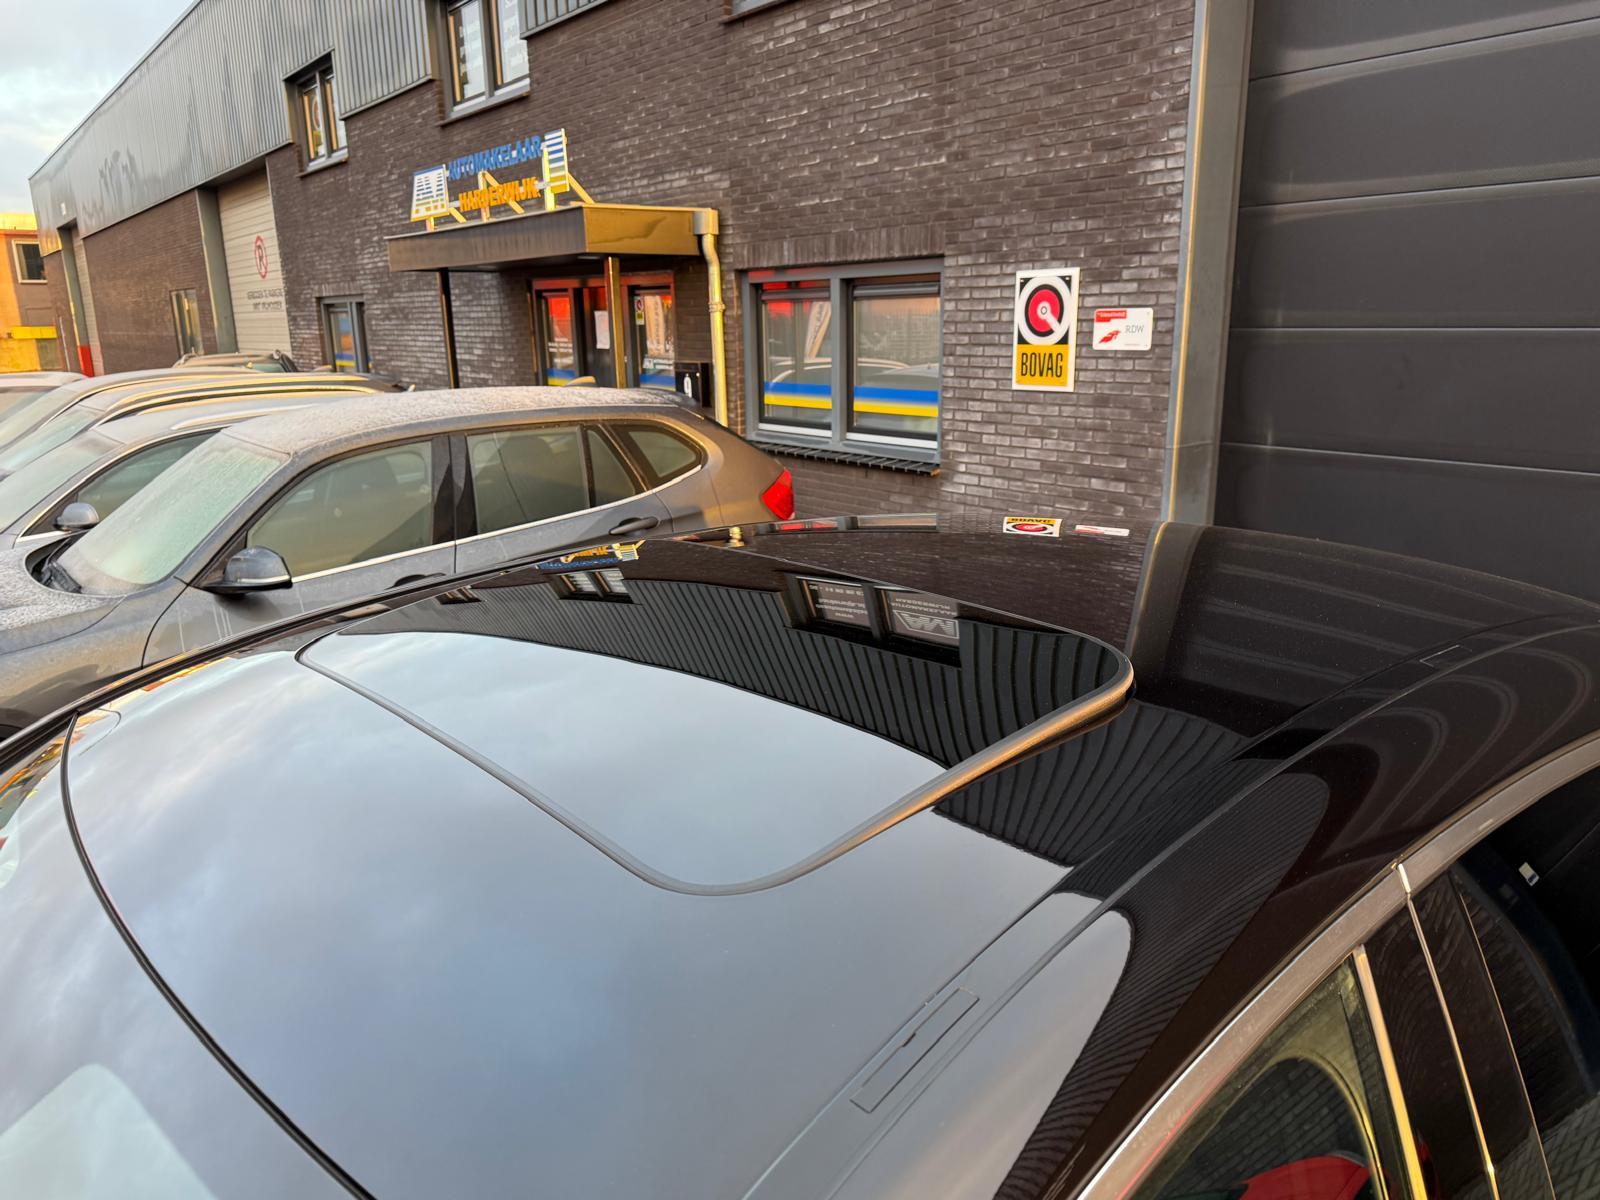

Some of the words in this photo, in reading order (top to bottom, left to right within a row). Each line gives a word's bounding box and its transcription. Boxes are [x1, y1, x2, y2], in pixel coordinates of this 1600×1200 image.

[448, 135, 541, 180] AUTOMAKELAAR
[459, 177, 538, 212] HARDERWIJK
[1124, 324, 1144, 334] RDW
[1020, 352, 1063, 378] BOVAG
